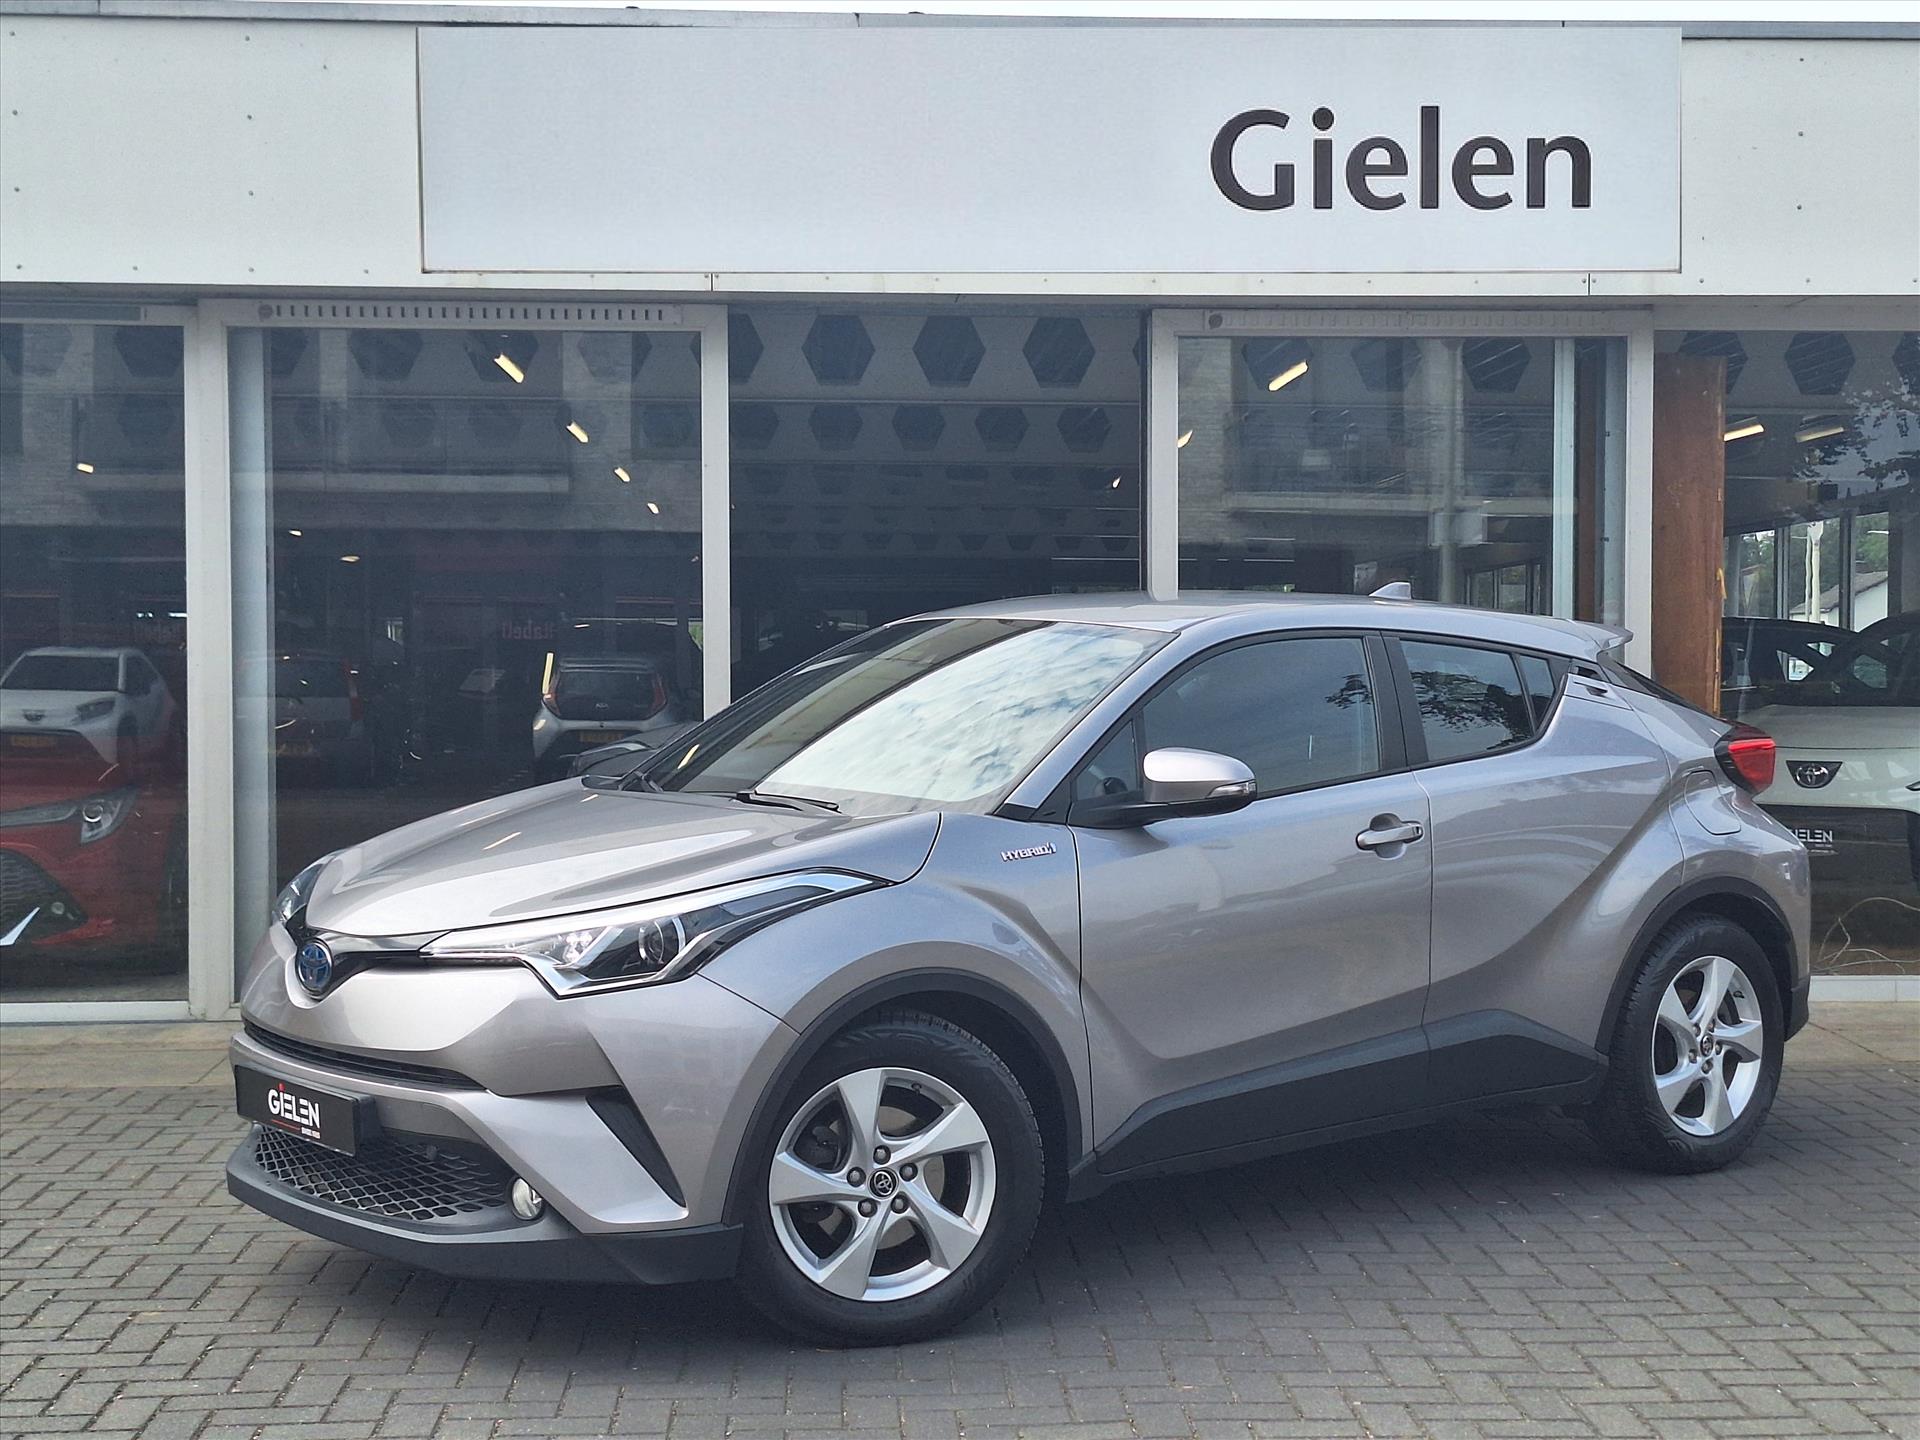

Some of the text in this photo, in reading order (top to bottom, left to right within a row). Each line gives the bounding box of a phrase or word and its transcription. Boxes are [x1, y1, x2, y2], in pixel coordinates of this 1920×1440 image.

[1210, 105, 1591, 211] Gielen
[1788, 829, 1833, 843] IELEN
[1001, 845, 1051, 861] HYBRID
[268, 1084, 320, 1128] GIELEN
